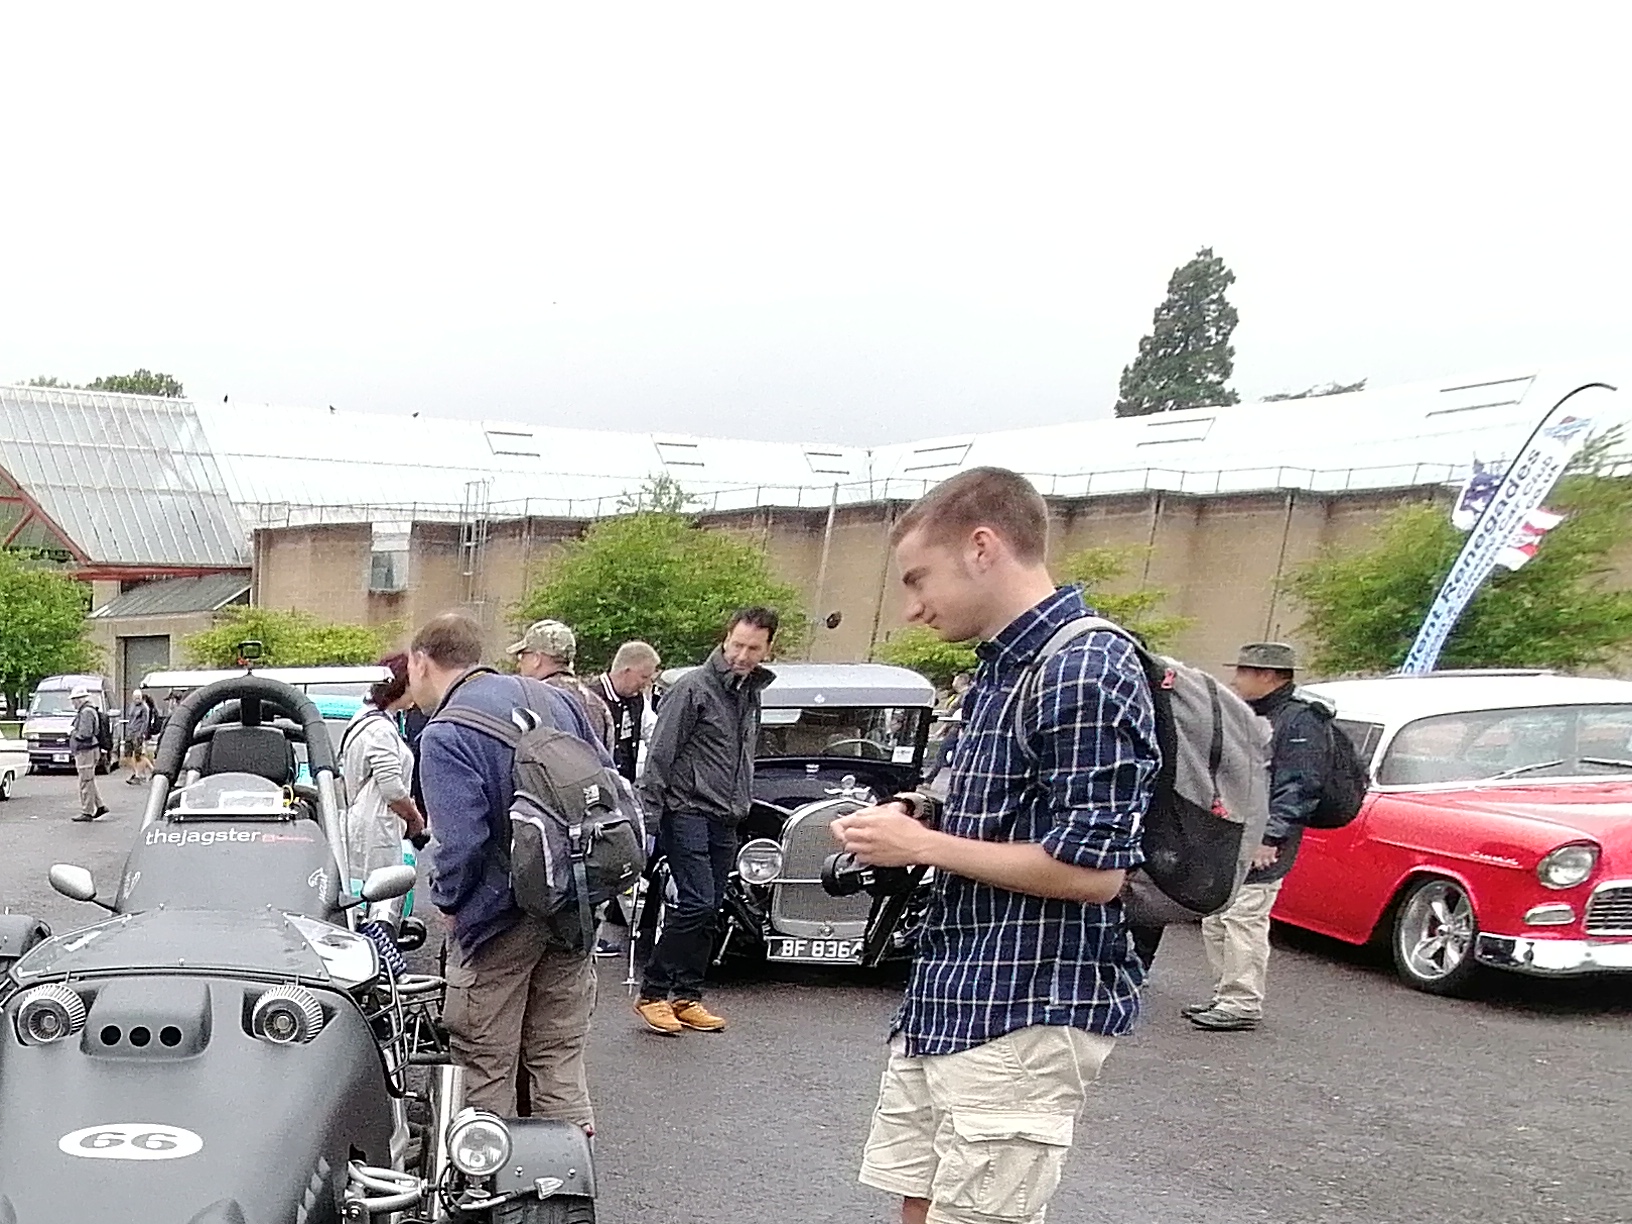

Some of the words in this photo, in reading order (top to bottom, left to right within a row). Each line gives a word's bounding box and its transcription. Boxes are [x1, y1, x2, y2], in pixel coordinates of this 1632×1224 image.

[145, 827, 262, 847] thejagster
[781, 940, 808, 957] BF
[79, 1131, 178, 1151] 66
